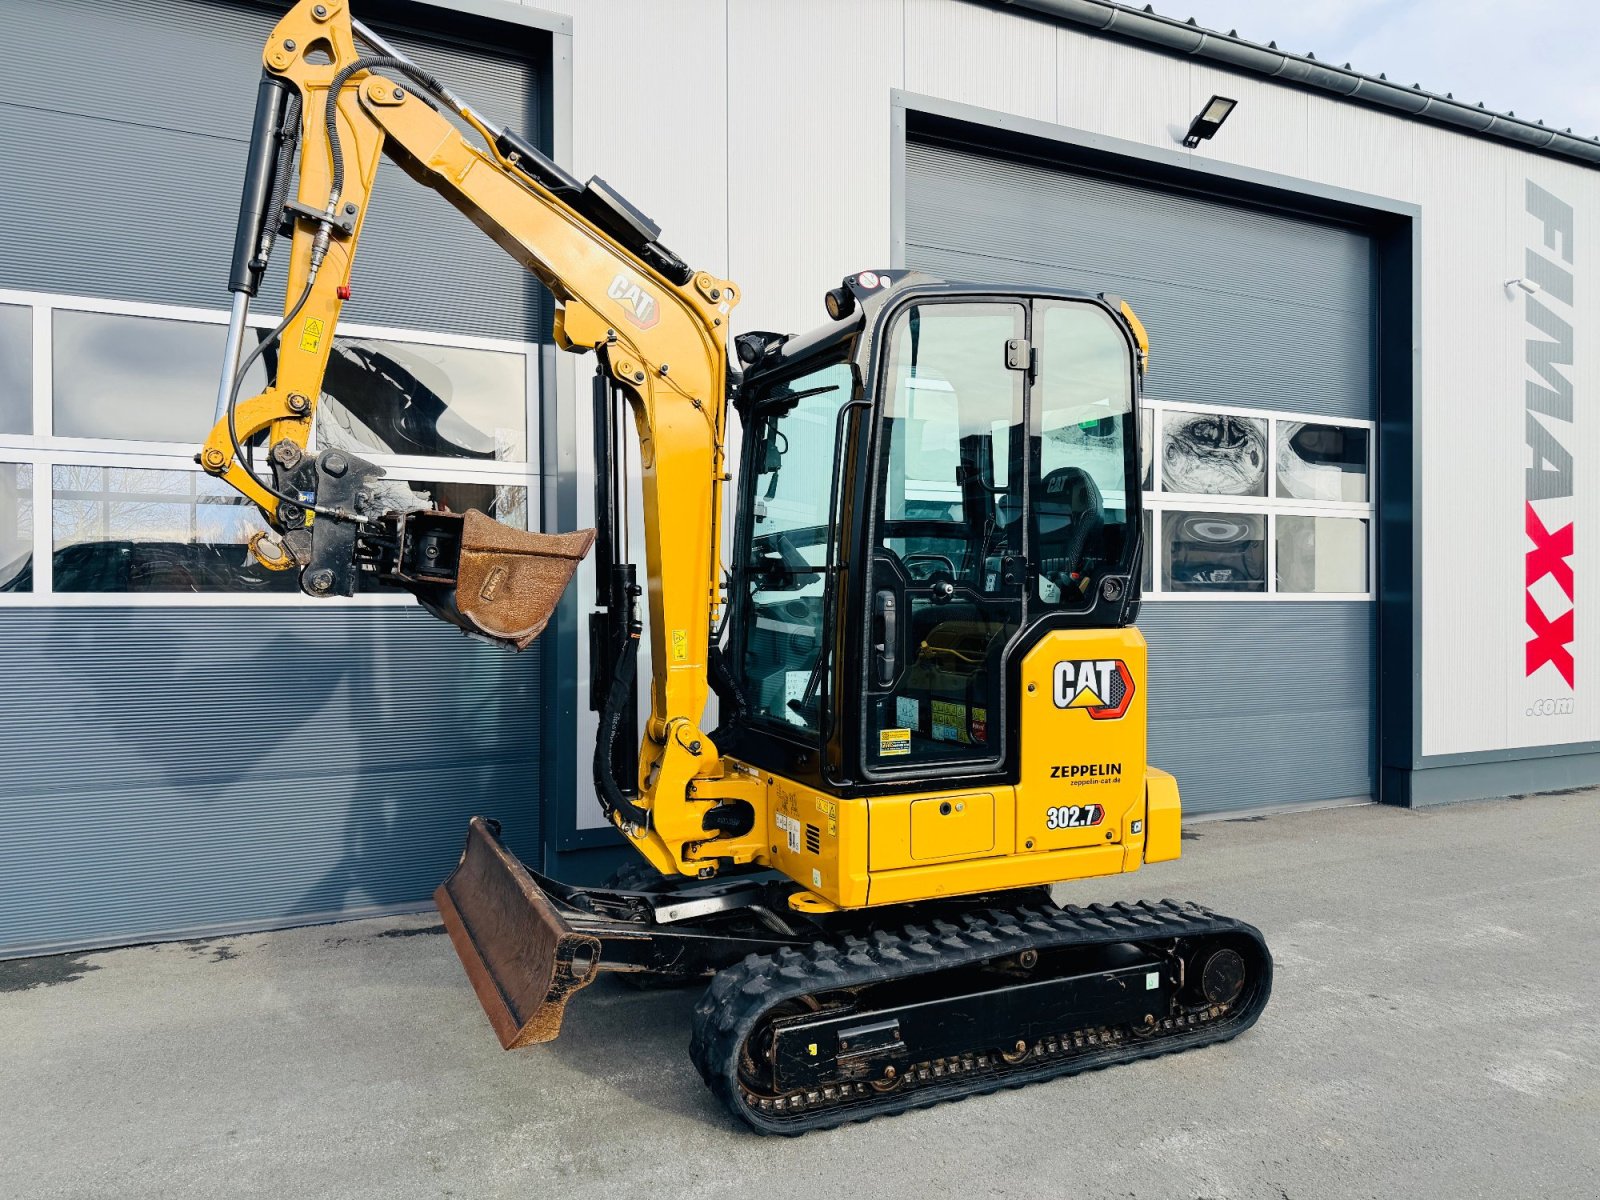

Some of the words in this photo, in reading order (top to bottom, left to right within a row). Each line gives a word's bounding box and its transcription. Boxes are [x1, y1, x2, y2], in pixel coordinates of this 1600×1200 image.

[608, 274, 655, 319] CAT
[1526, 177, 1574, 691] FIMAXX
[1047, 476, 1068, 493] CAT
[1053, 660, 1116, 708] CAT
[1526, 697, 1574, 716] .com
[1050, 763, 1122, 778] ZEPPELIN
[1070, 777, 1121, 787] zeppelin-cat.de
[1046, 804, 1096, 829] 302.7
